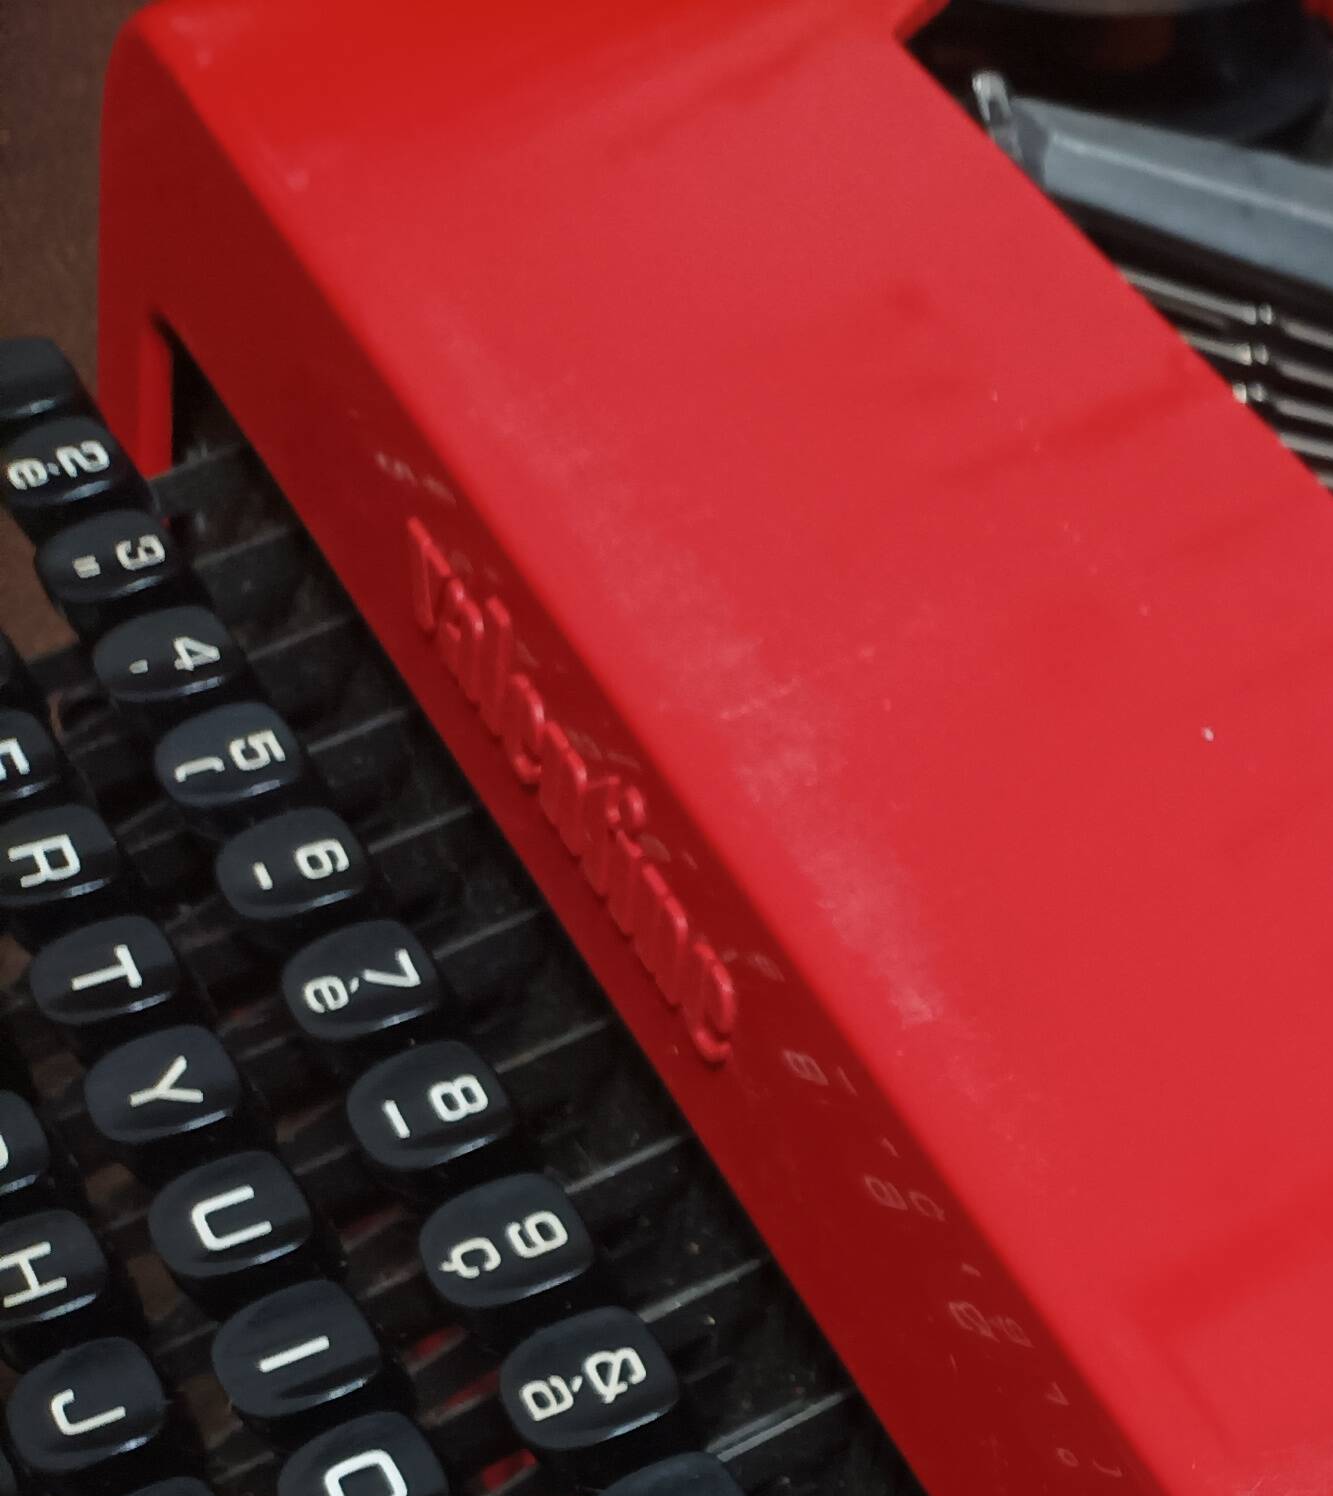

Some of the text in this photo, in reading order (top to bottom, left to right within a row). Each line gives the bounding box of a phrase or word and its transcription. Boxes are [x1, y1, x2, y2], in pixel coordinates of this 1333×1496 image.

[56, 440, 111, 478] 2
[115, 535, 166, 570] 3
[173, 637, 220, 671] 4
[229, 730, 286, 771] 5
[8, 834, 81, 888] R
[294, 838, 350, 880] 6
[71, 944, 143, 990] T
[363, 949, 421, 988] 7
[130, 1055, 204, 1106] Y
[428, 1074, 489, 1122] 8
[190, 1185, 272, 1251] U
[505, 1211, 568, 1258] 9
[0, 1241, 68, 1308] H
[258, 1335, 330, 1373] I
[50, 1388, 126, 1436] J
